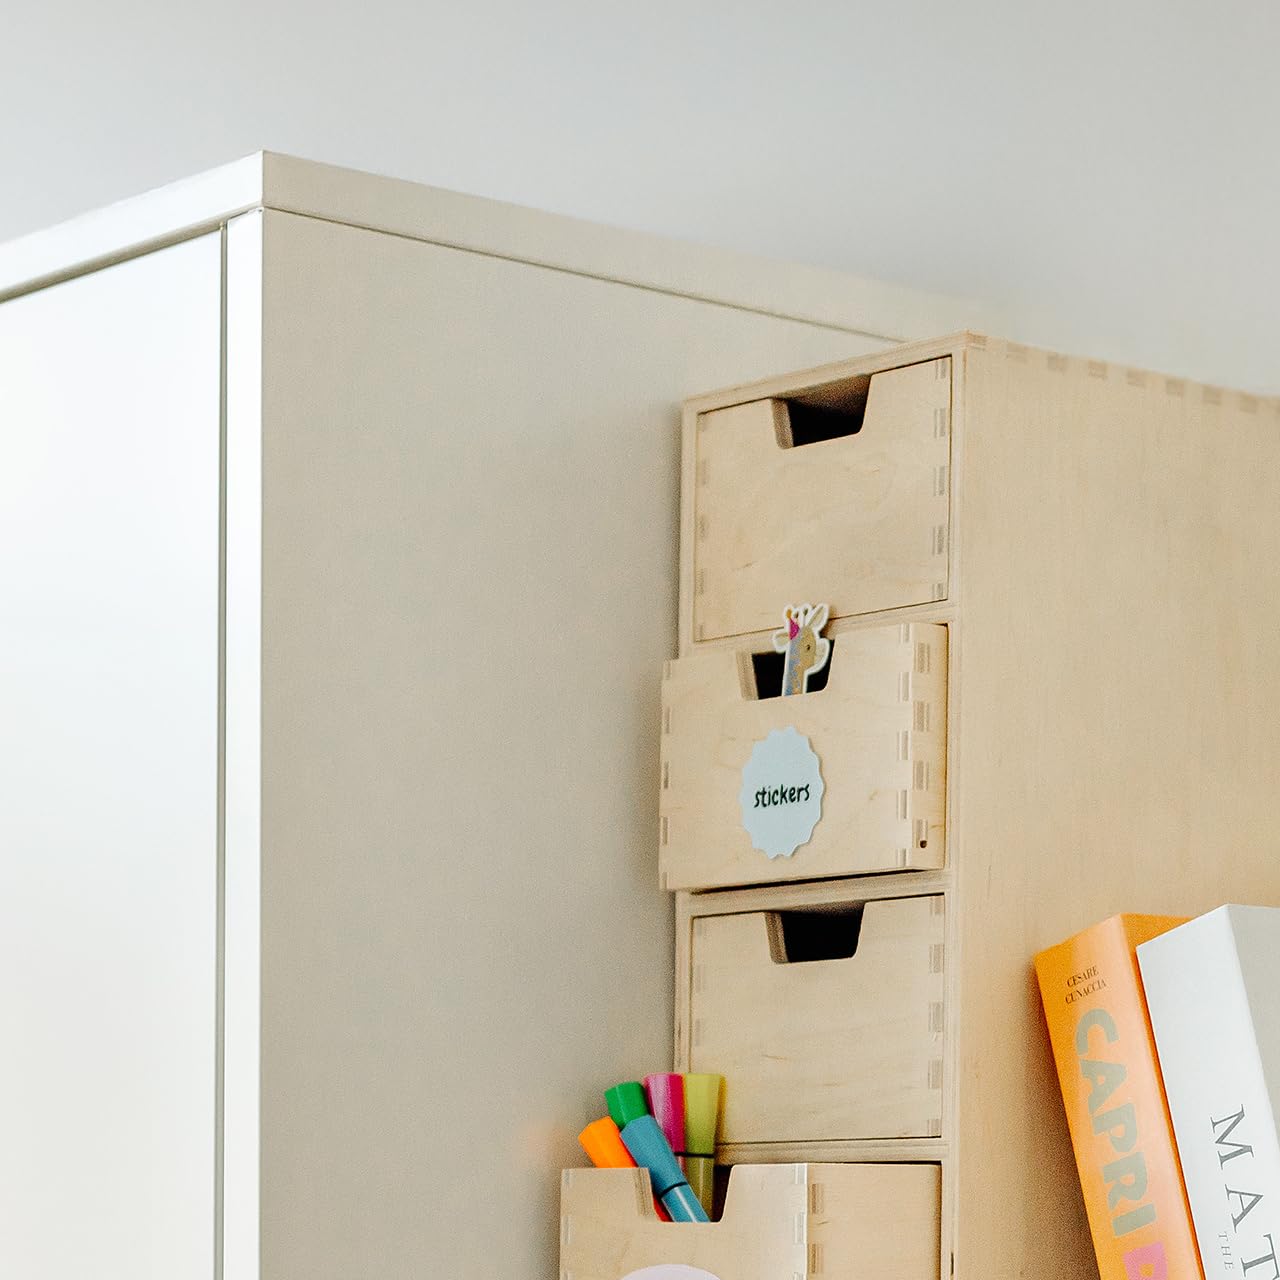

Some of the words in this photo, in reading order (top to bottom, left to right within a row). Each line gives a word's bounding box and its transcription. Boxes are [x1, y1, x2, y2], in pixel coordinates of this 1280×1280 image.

[754, 784, 810, 808] stickers
[1066, 965, 1100, 988] CESARE
[1075, 1008, 1157, 1237] CAPRI
[1218, 1231, 1234, 1271] THE
